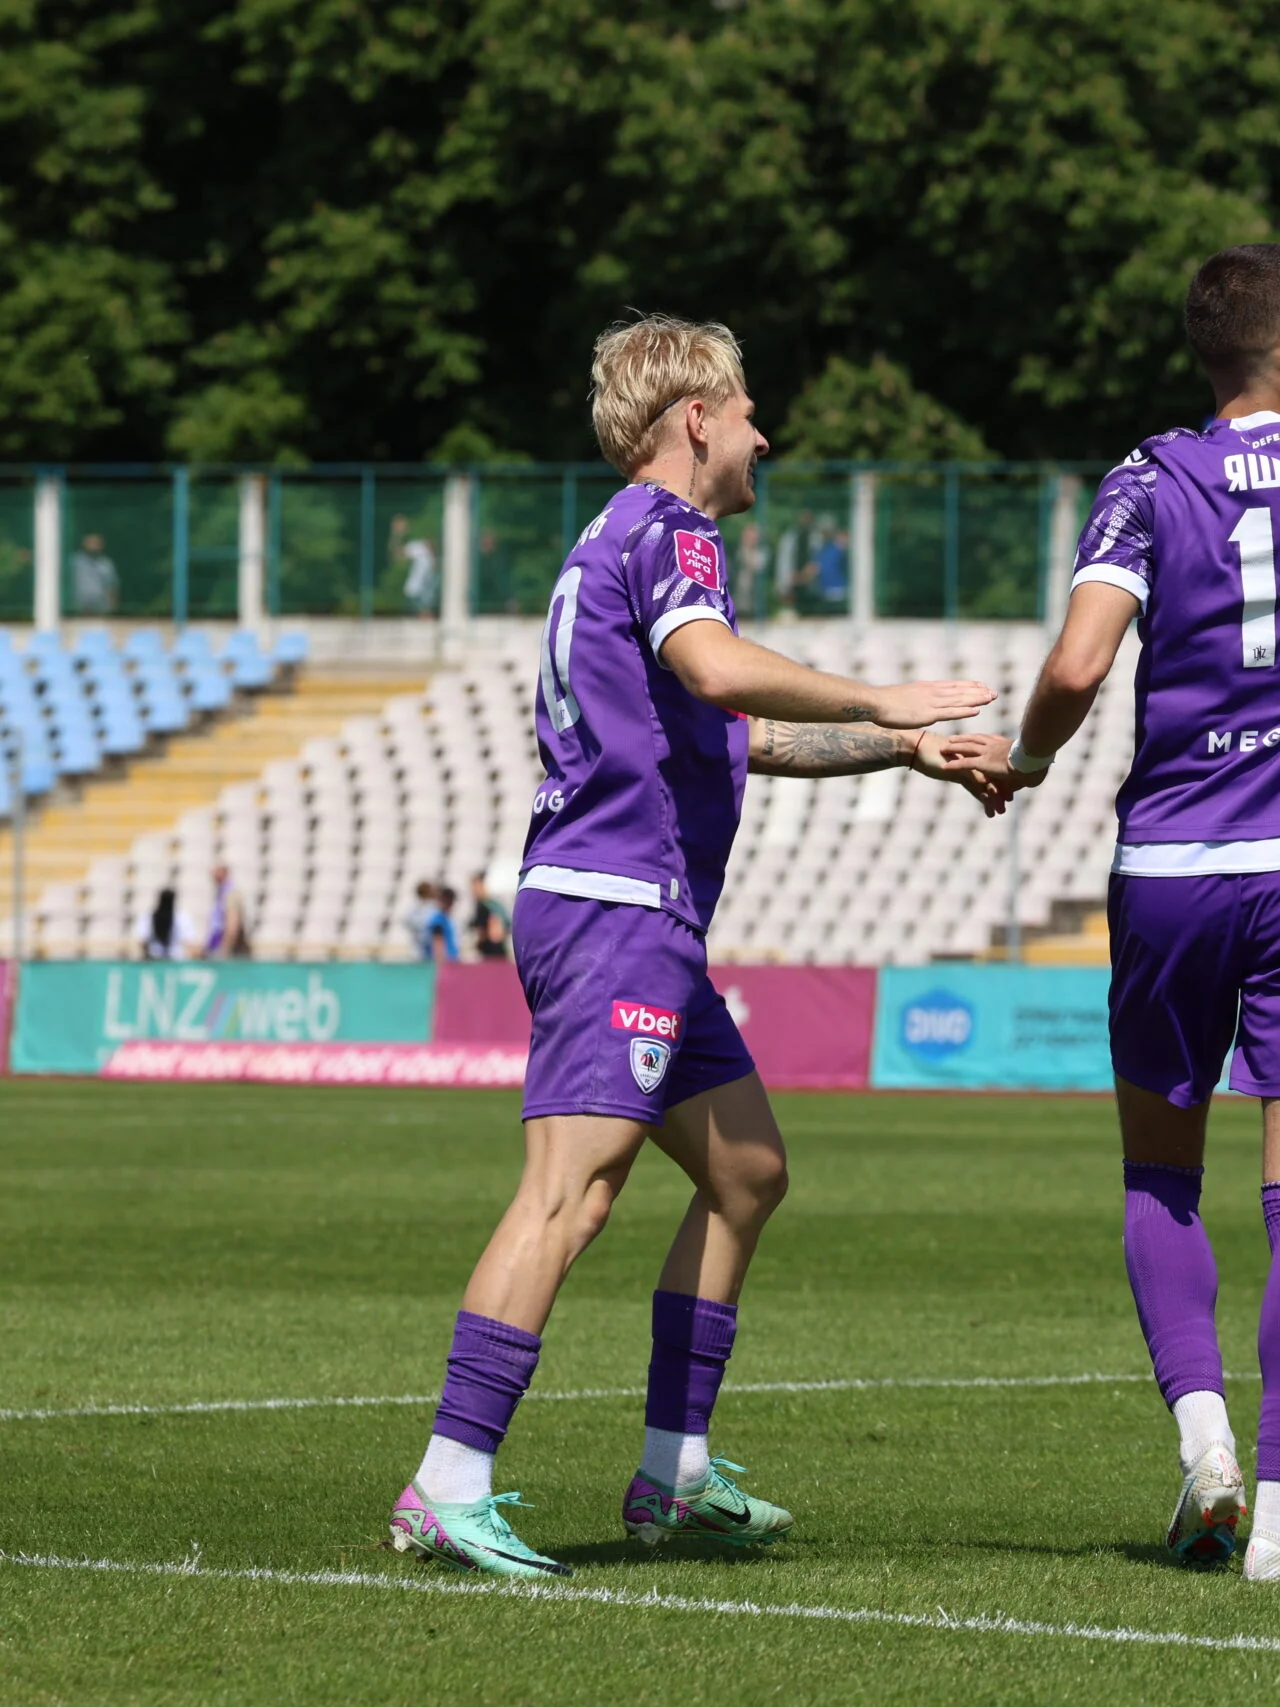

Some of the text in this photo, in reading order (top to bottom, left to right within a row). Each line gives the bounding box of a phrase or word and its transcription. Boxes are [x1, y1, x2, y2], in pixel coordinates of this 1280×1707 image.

[683, 548, 713, 567] vbet
[103, 968, 217, 1041] LNZ
[618, 1007, 678, 1041] vbet
